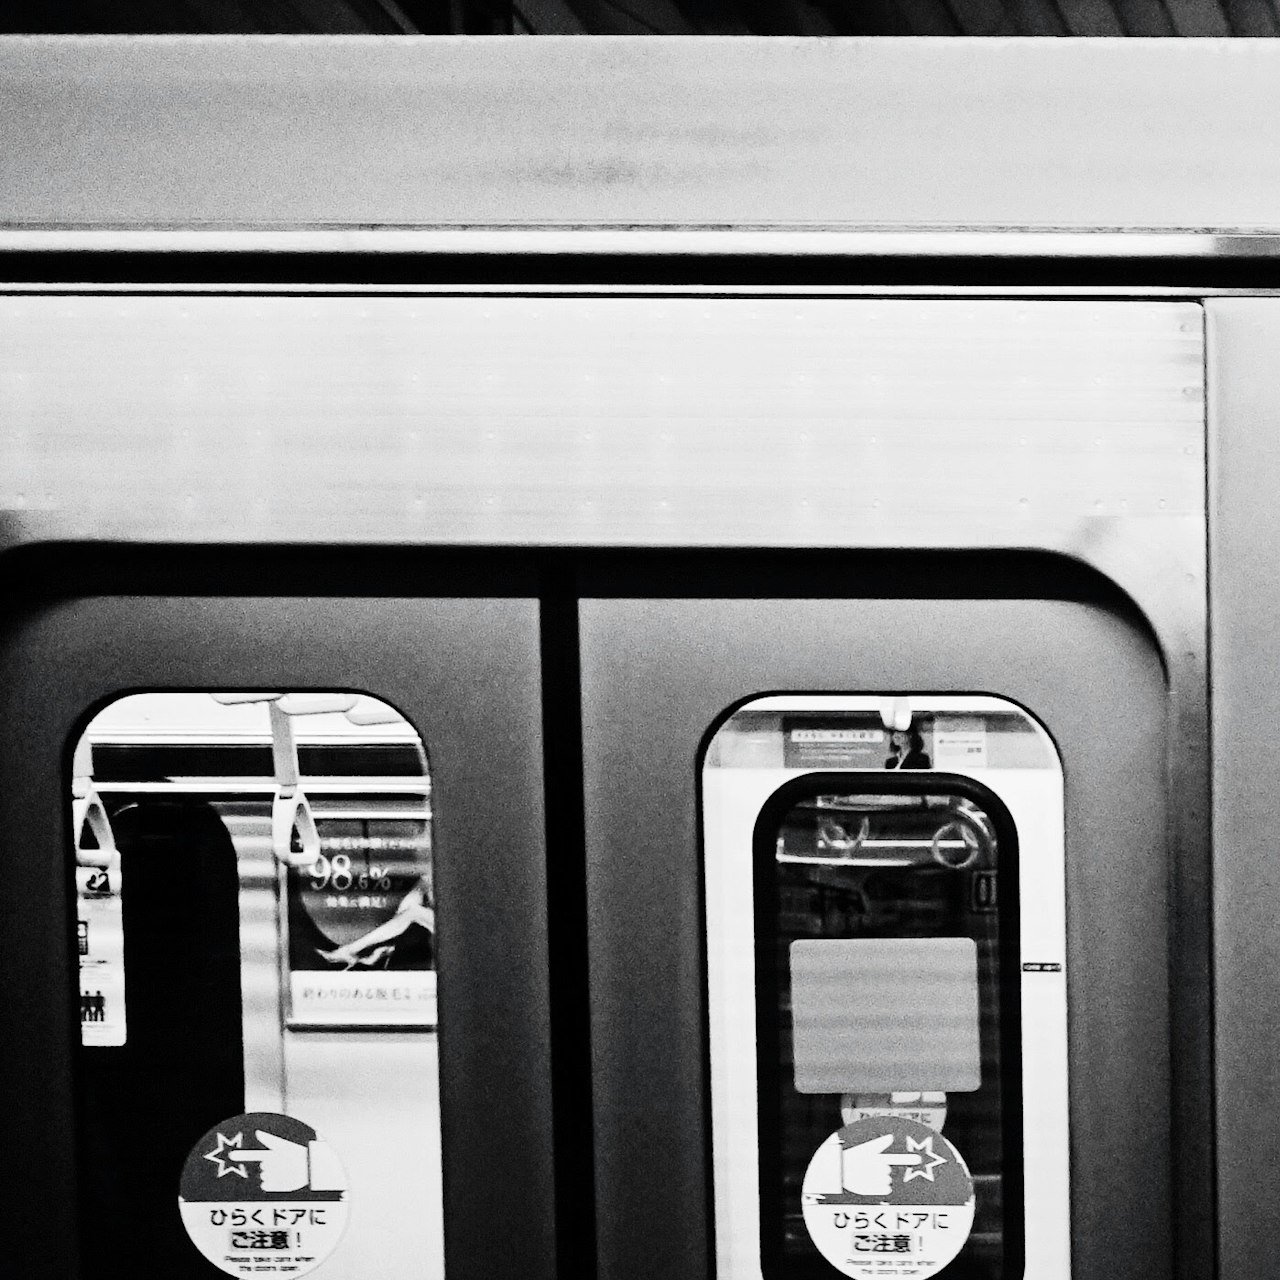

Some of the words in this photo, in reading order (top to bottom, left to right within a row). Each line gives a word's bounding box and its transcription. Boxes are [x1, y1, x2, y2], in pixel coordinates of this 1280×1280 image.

[210, 1208, 326, 1226] ひらくドアに
[833, 1212, 949, 1230] ひらくドアに
[232, 1230, 301, 1249] ご注意！
[854, 1234, 923, 1253] ご注意！
